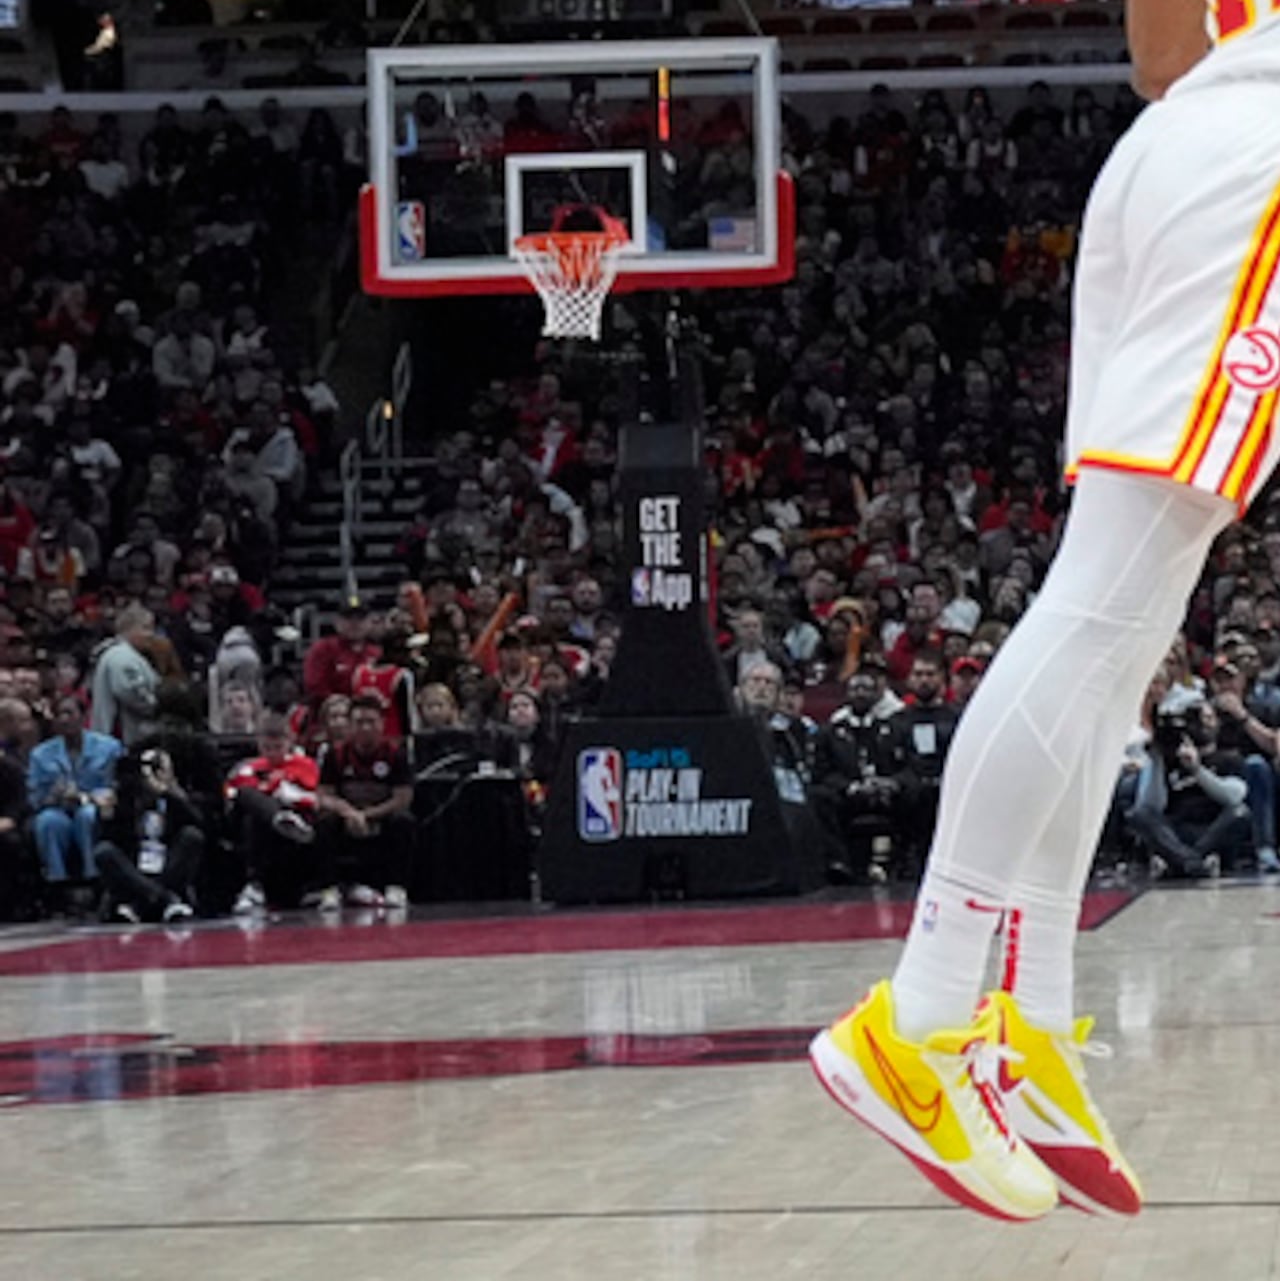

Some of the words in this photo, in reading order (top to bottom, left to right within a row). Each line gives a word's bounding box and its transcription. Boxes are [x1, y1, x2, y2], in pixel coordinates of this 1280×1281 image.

[639, 497, 681, 532] GET
[641, 532, 682, 567] THE
[651, 570, 692, 611] App
[625, 768, 702, 802] PLAY-IN
[625, 799, 752, 837] TOURNAMENT
